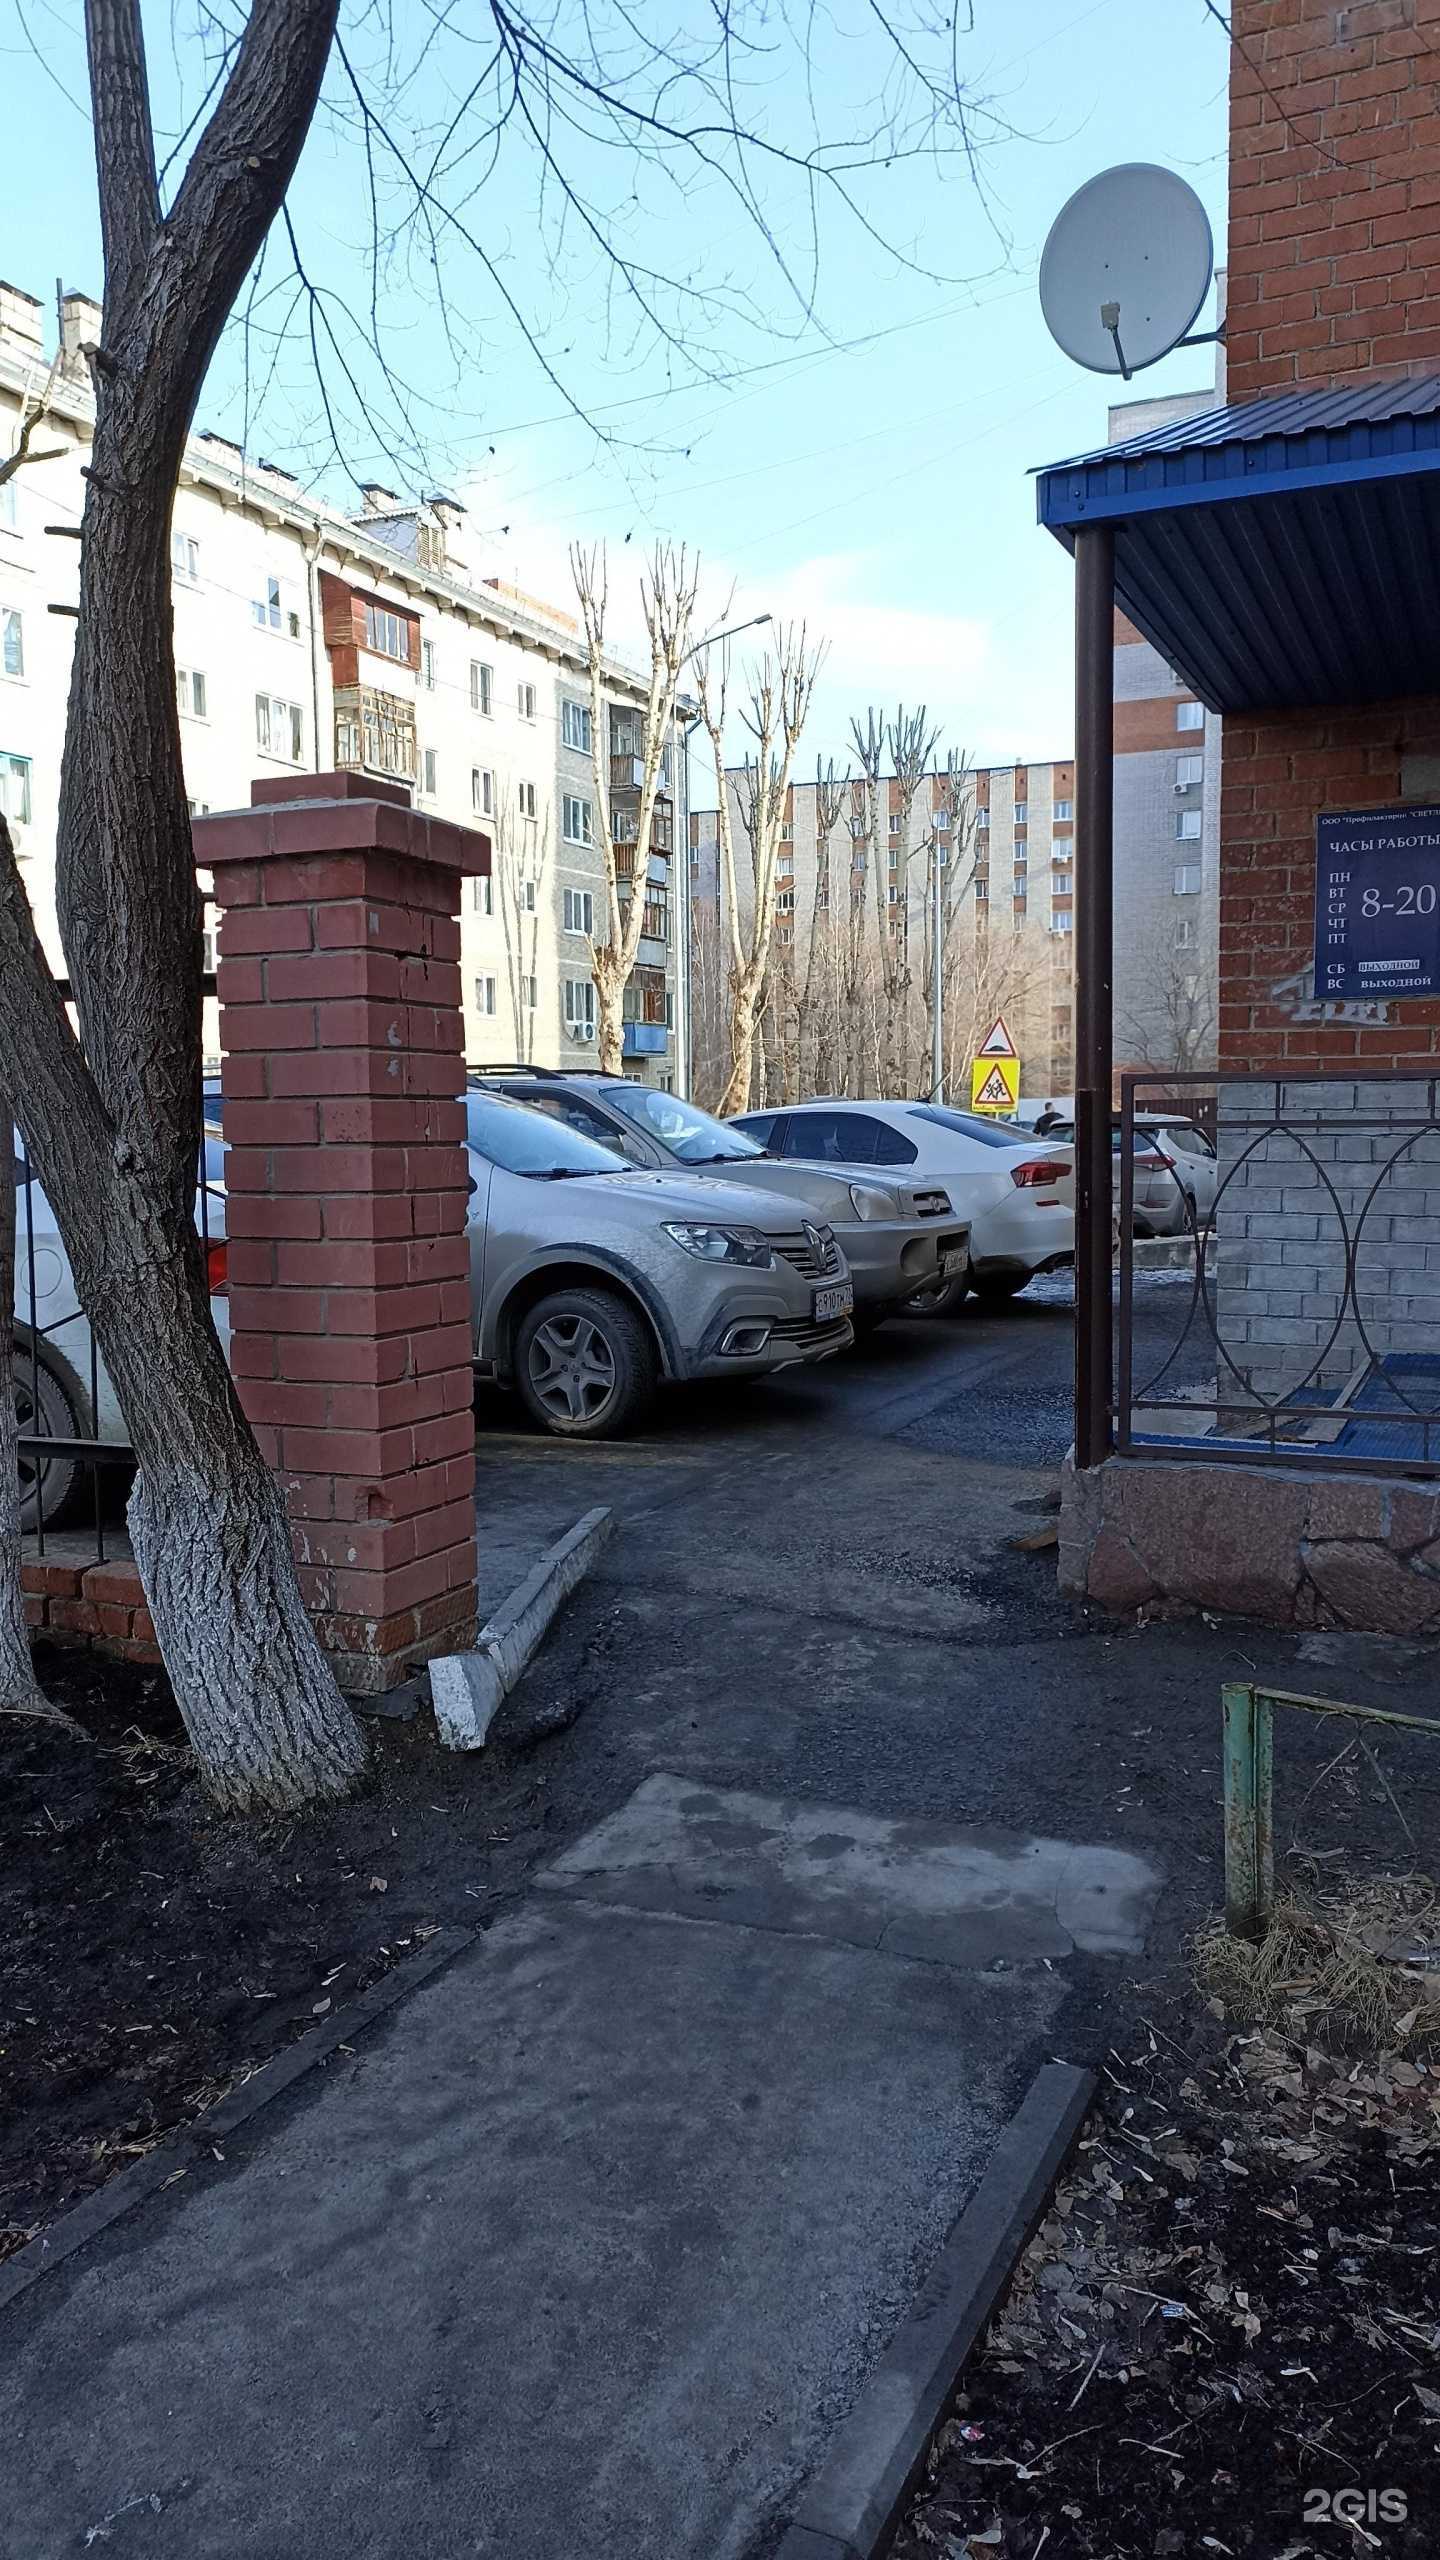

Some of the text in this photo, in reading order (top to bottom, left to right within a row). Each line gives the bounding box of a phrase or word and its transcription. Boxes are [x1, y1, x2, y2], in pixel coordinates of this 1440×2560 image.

[1329, 834, 1440, 853] ЧАСЫ РАБОТЫ
[1329, 871, 1351, 883] ПН
[1329, 887, 1346, 899] ВТ
[1361, 884, 1437, 918] 8-20
[1328, 902, 1347, 914] СР
[1328, 918, 1347, 929] ЧТ
[1328, 933, 1348, 944] ПТ
[1327, 963, 1346, 974] СБ
[1327, 978, 1345, 989] ВС
